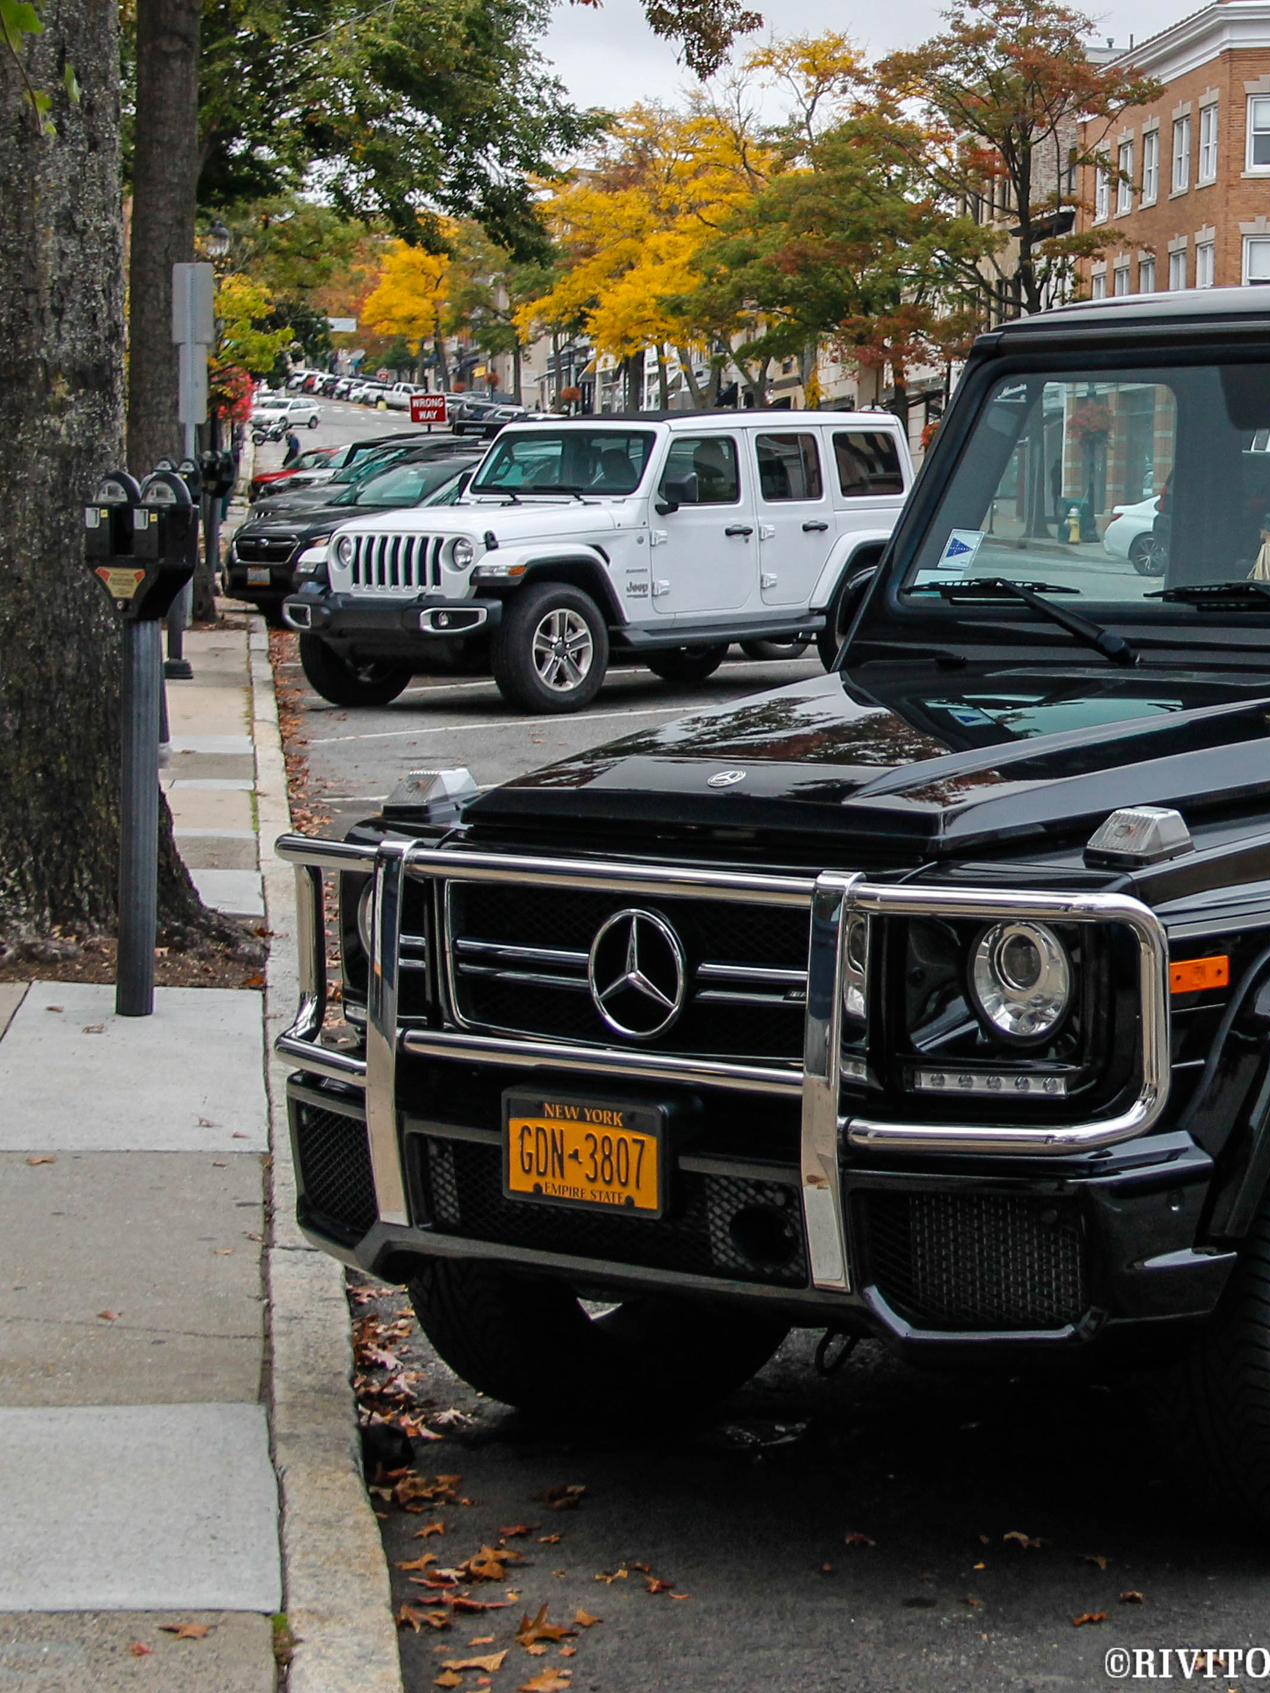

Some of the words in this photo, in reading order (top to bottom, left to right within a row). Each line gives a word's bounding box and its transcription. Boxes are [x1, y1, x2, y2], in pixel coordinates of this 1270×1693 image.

[412, 398, 443, 408] WRONG
[418, 410, 438, 420] WAY
[626, 581, 648, 593] Jeep
[543, 1102, 580, 1120] NEW
[583, 1107, 624, 1127] YORK
[519, 1125, 565, 1179] GDN
[585, 1132, 646, 1189] 3807
[544, 1181, 586, 1199] EMPIRE
[590, 1189, 625, 1204] STATE
